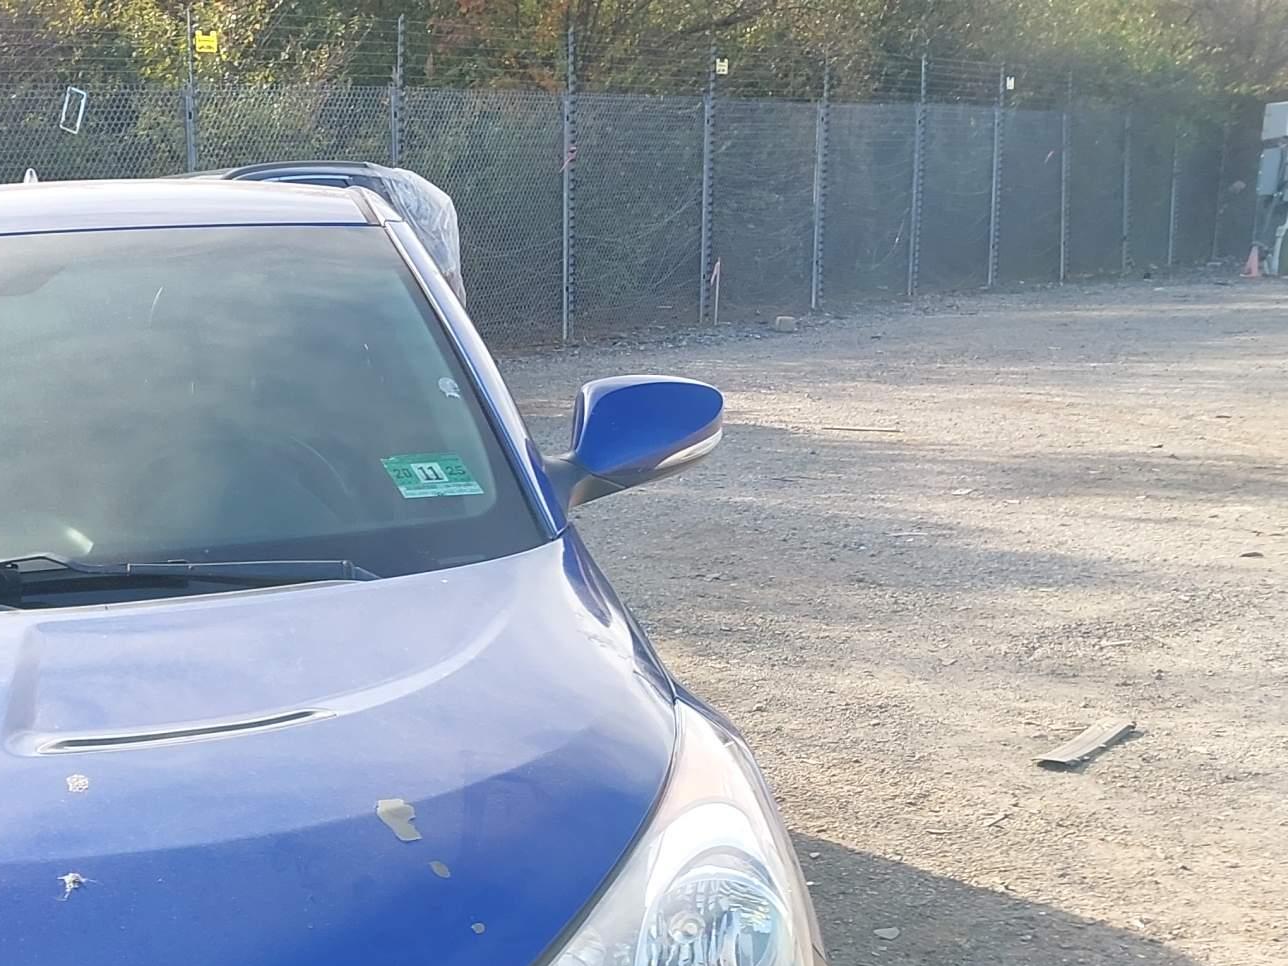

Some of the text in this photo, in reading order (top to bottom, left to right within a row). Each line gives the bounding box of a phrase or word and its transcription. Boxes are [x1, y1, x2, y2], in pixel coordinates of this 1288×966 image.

[393, 465, 466, 480] 20 11 25
